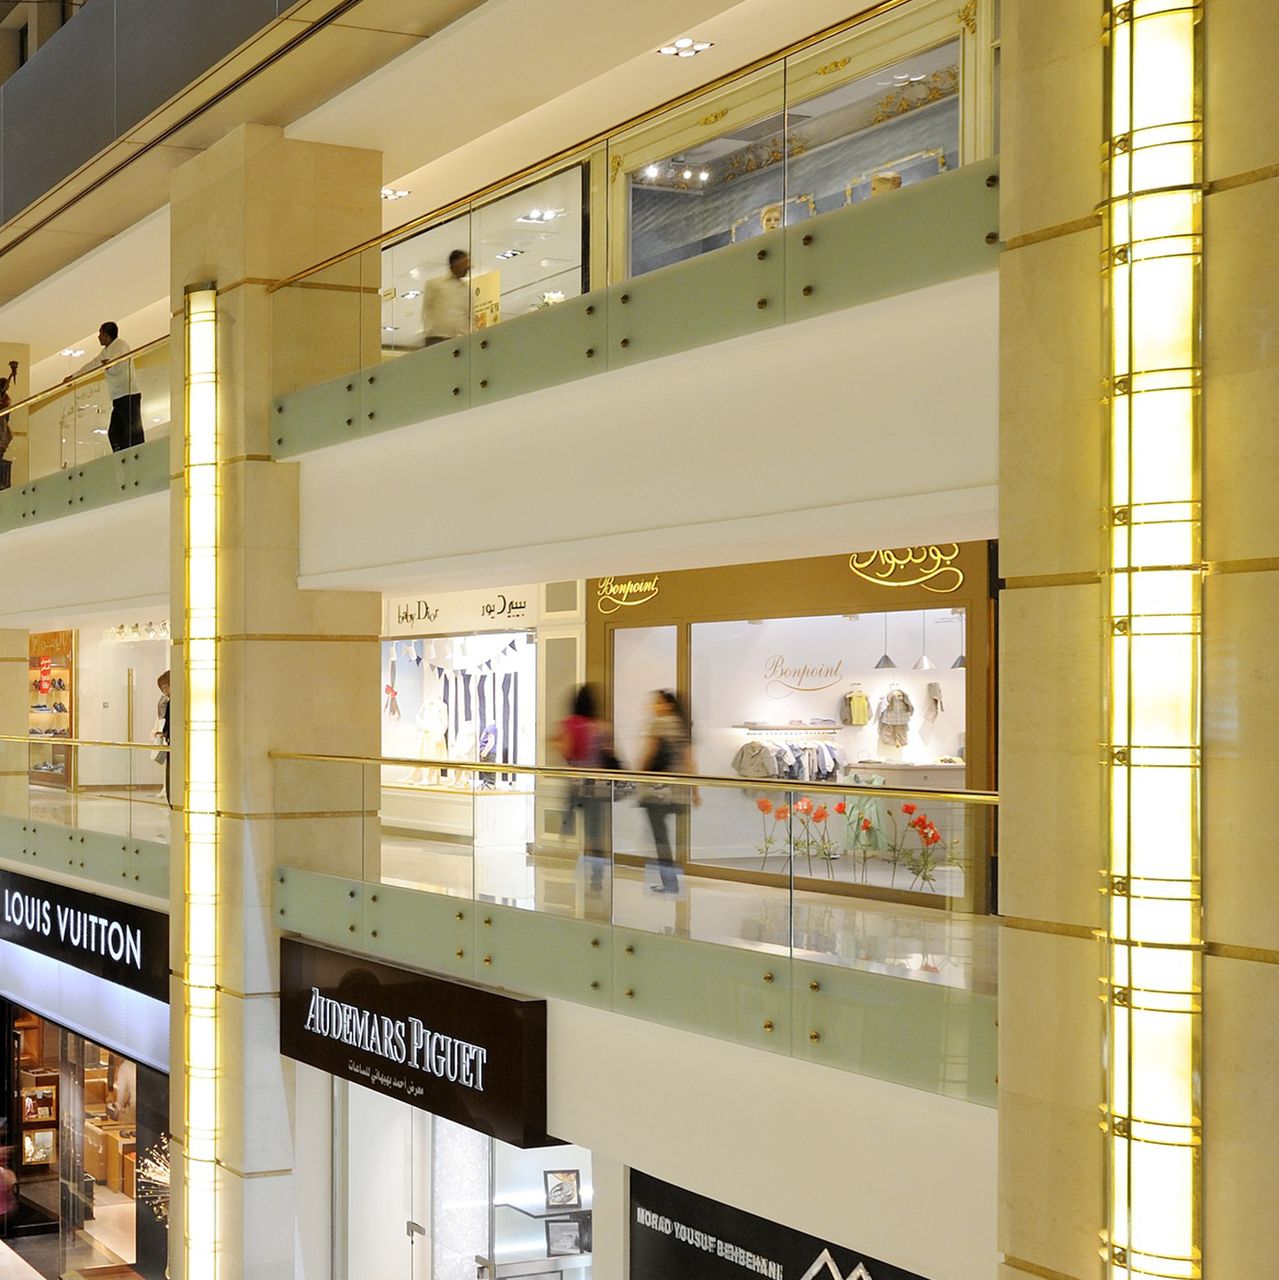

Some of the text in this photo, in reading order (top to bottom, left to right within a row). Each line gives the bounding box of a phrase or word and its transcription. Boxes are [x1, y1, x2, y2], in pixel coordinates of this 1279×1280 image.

[417, 599, 439, 622] Dior
[597, 575, 659, 607] Bonpoint
[763, 655, 844, 693] Bonpoint
[4, 888, 142, 970] LOUIS VUITTON
[304, 986, 487, 1092] AUDEMARS PIGUET
[636, 1206, 674, 1236] MORAD
[673, 1221, 717, 1253] YOUSUF
